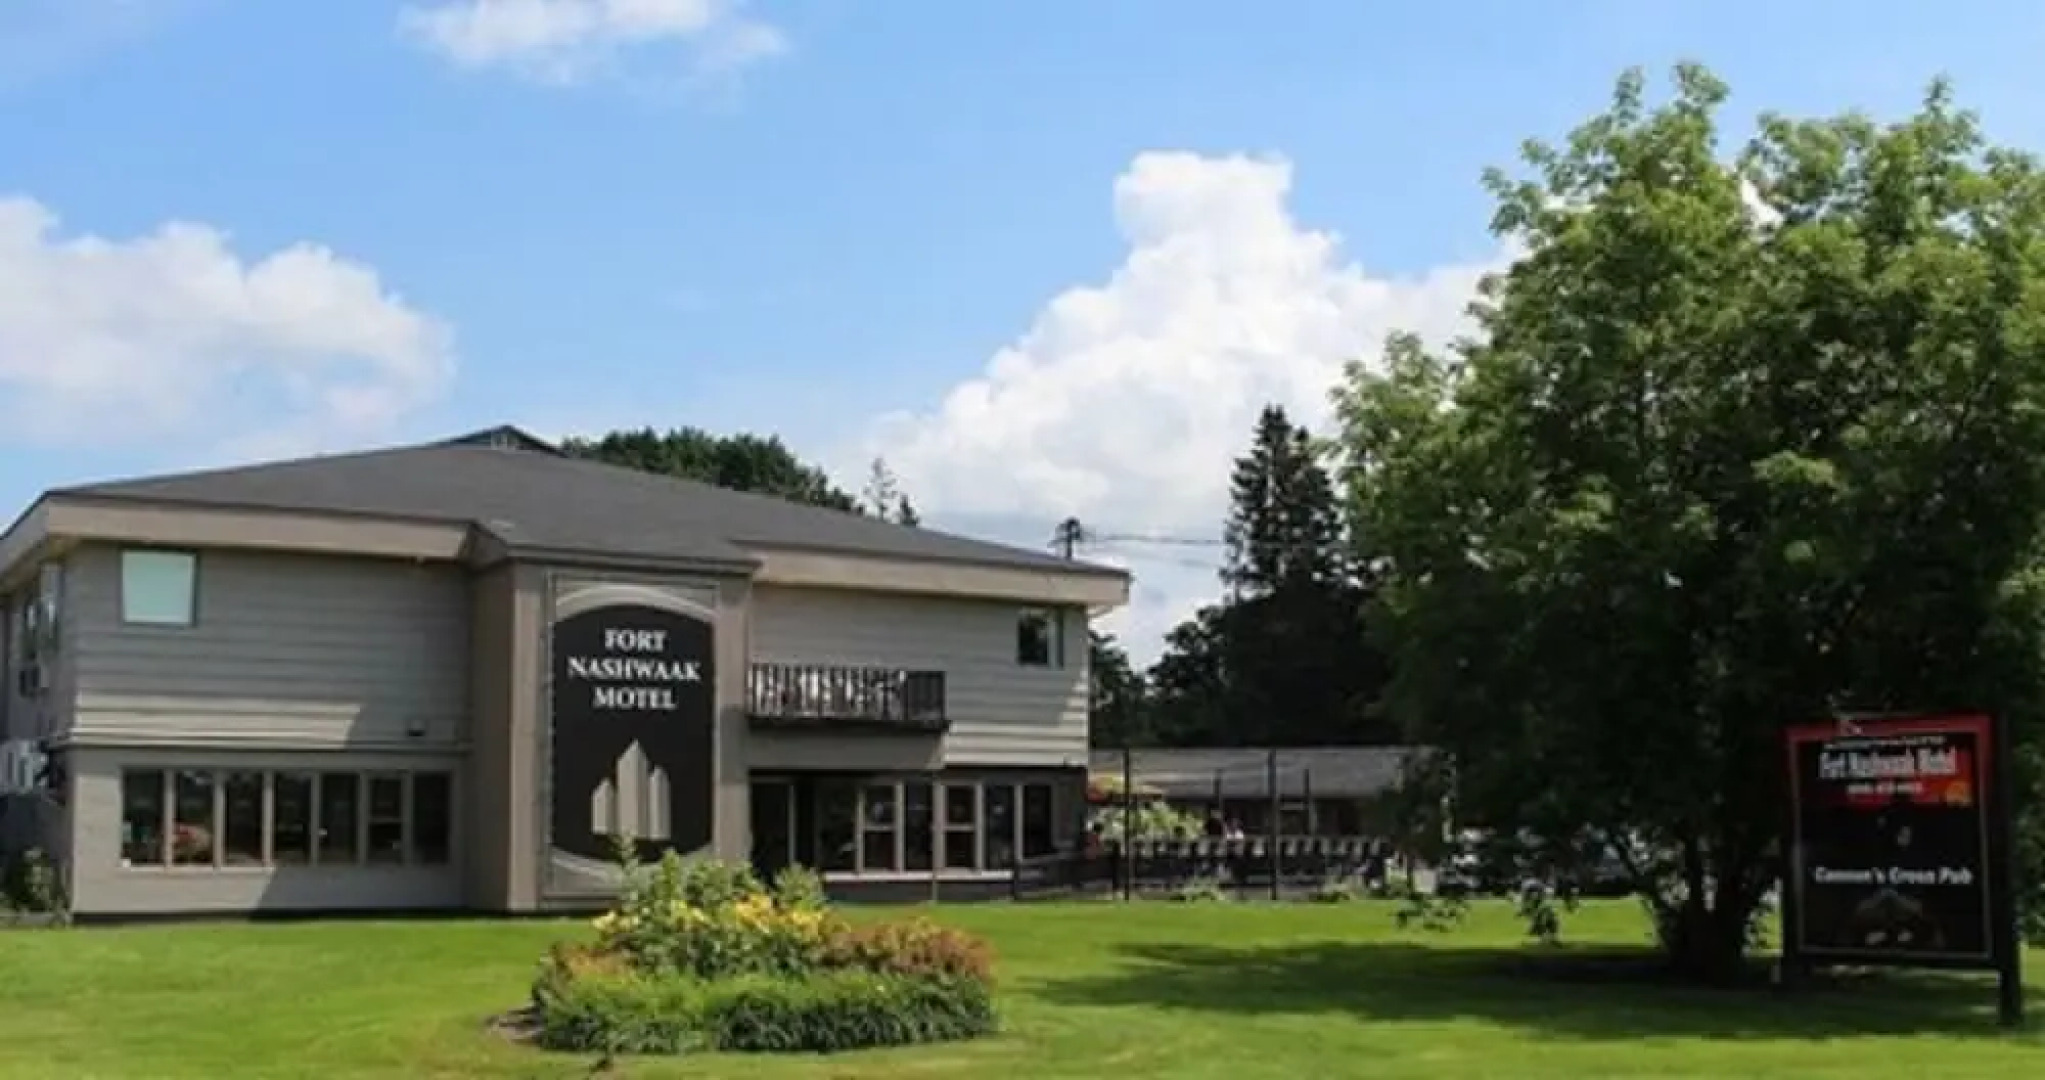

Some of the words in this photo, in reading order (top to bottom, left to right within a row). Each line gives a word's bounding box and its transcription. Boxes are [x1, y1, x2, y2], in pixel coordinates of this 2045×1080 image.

[604, 628, 667, 651] FORT
[567, 656, 701, 682] NASHWAAK
[593, 686, 678, 710] MOTEL
[1819, 751, 1846, 779] Fort
[1938, 866, 1974, 885] Pub
